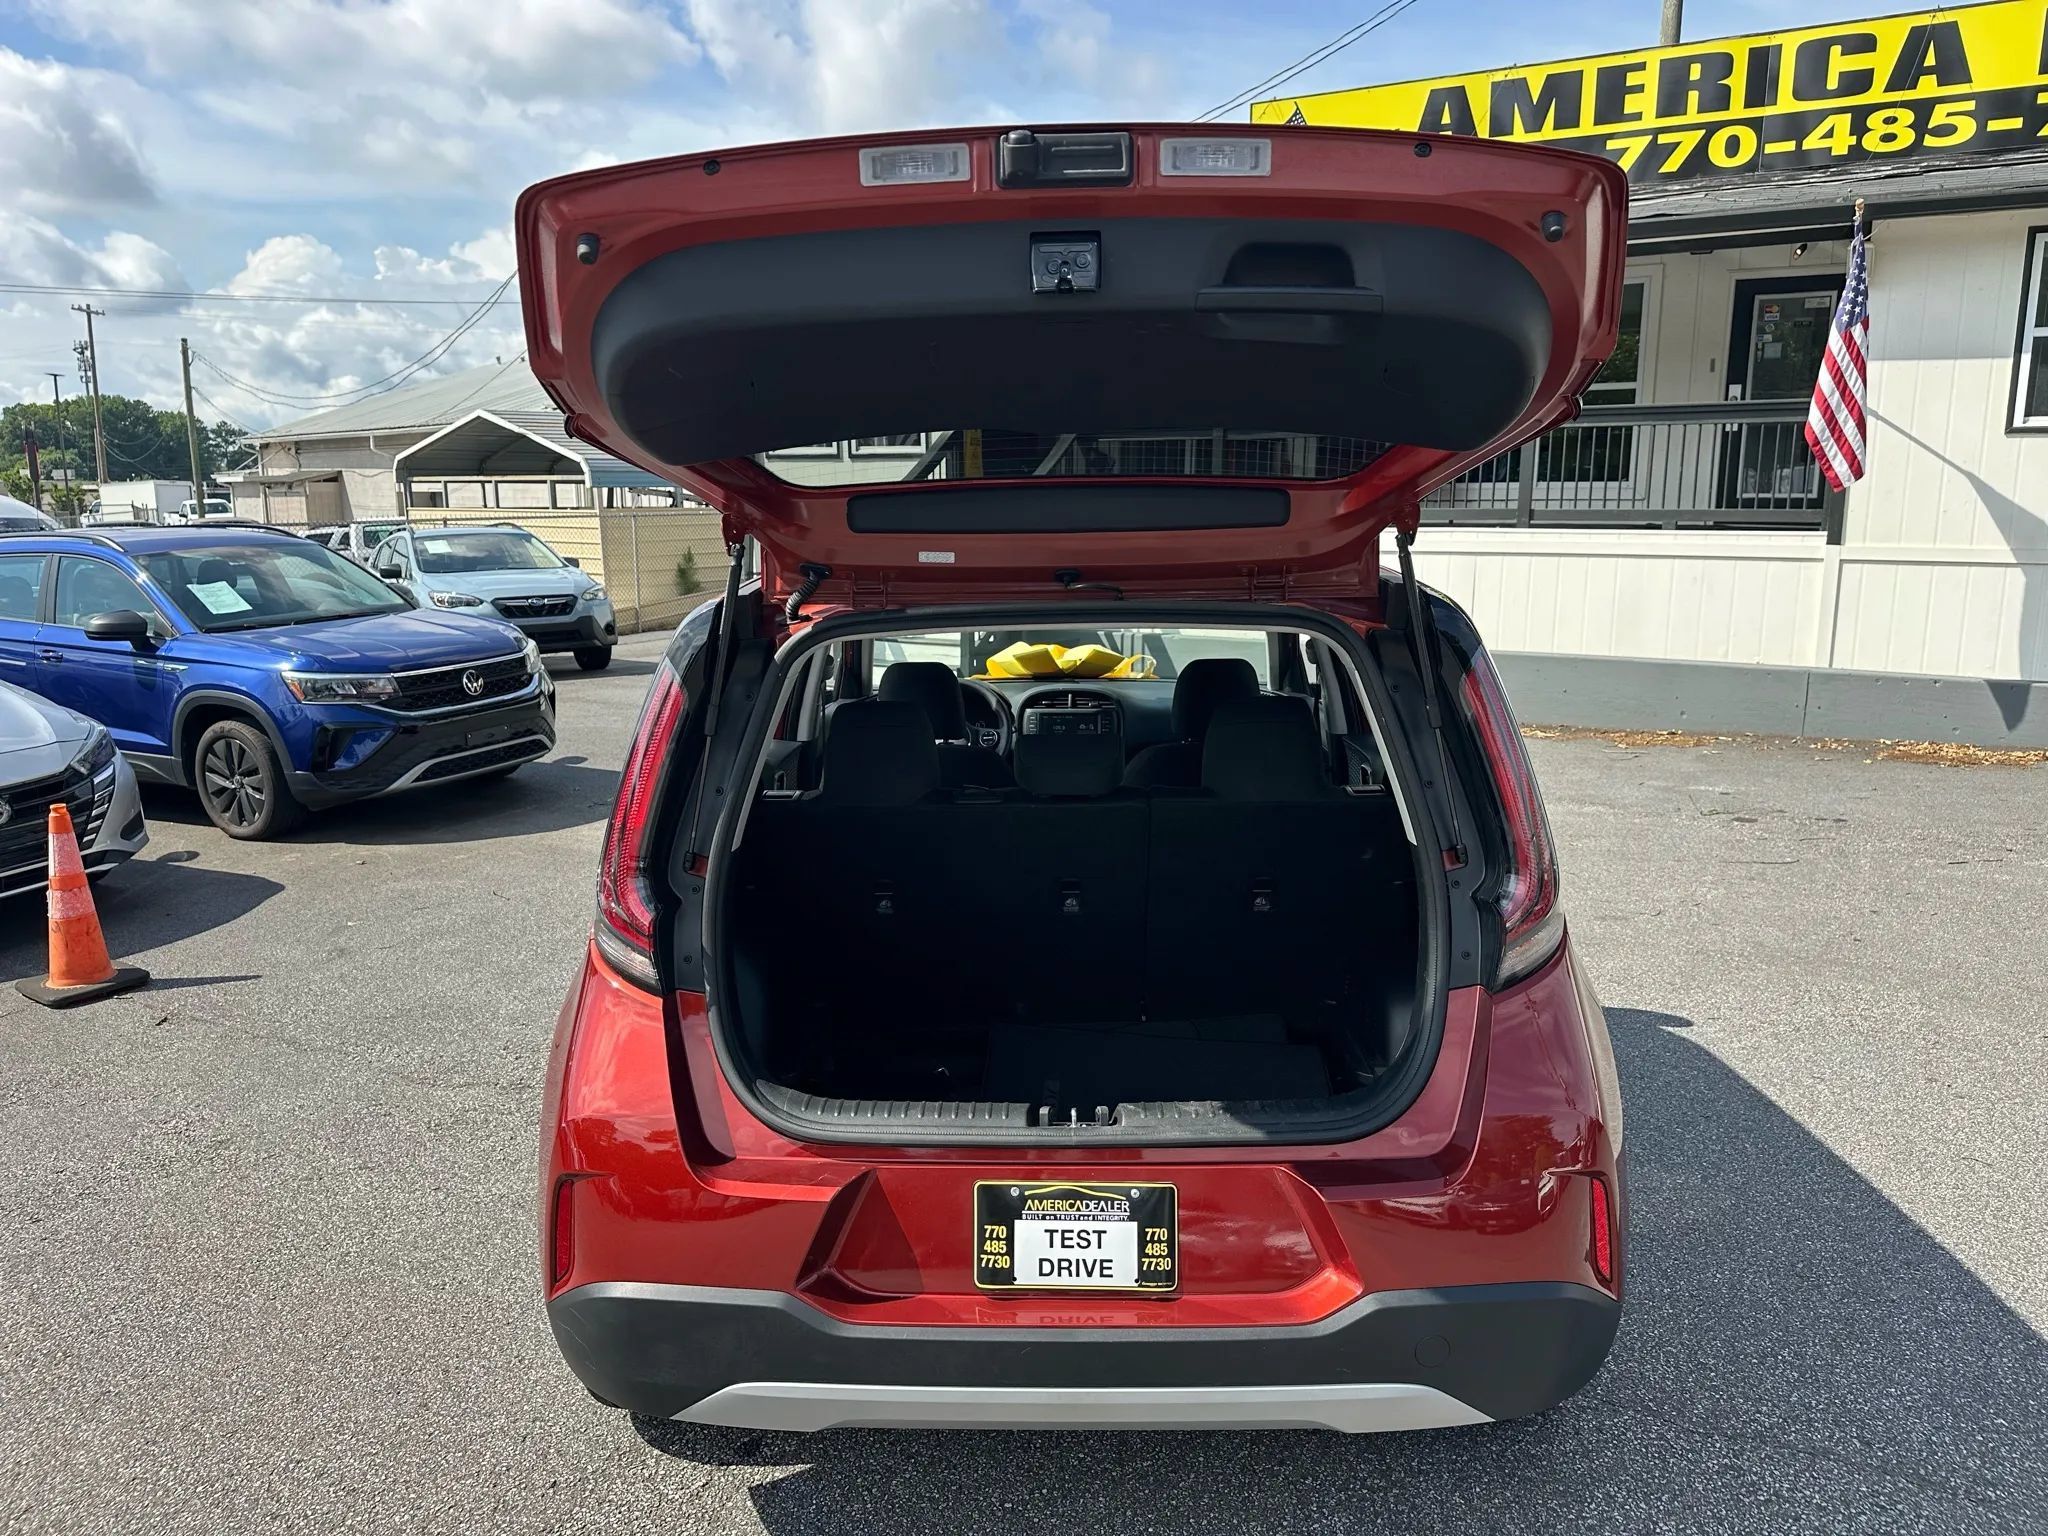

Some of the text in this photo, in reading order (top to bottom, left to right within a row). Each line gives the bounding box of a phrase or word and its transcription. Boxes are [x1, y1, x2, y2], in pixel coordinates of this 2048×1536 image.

[1417, 20, 1974, 139] AMERICA
[1606, 92, 2048, 173] 770-485-
[1024, 1199, 1130, 1213] AMERICADEALER
[983, 1224, 1007, 1239] 770
[1144, 1227, 1168, 1241] 770
[983, 1239, 1007, 1254] 485
[1044, 1229, 1108, 1250] TEST
[1144, 1242, 1168, 1256] 485
[980, 1254, 1010, 1269] 7730
[1038, 1257, 1114, 1278] DRIVE
[1141, 1257, 1172, 1271] 7730
